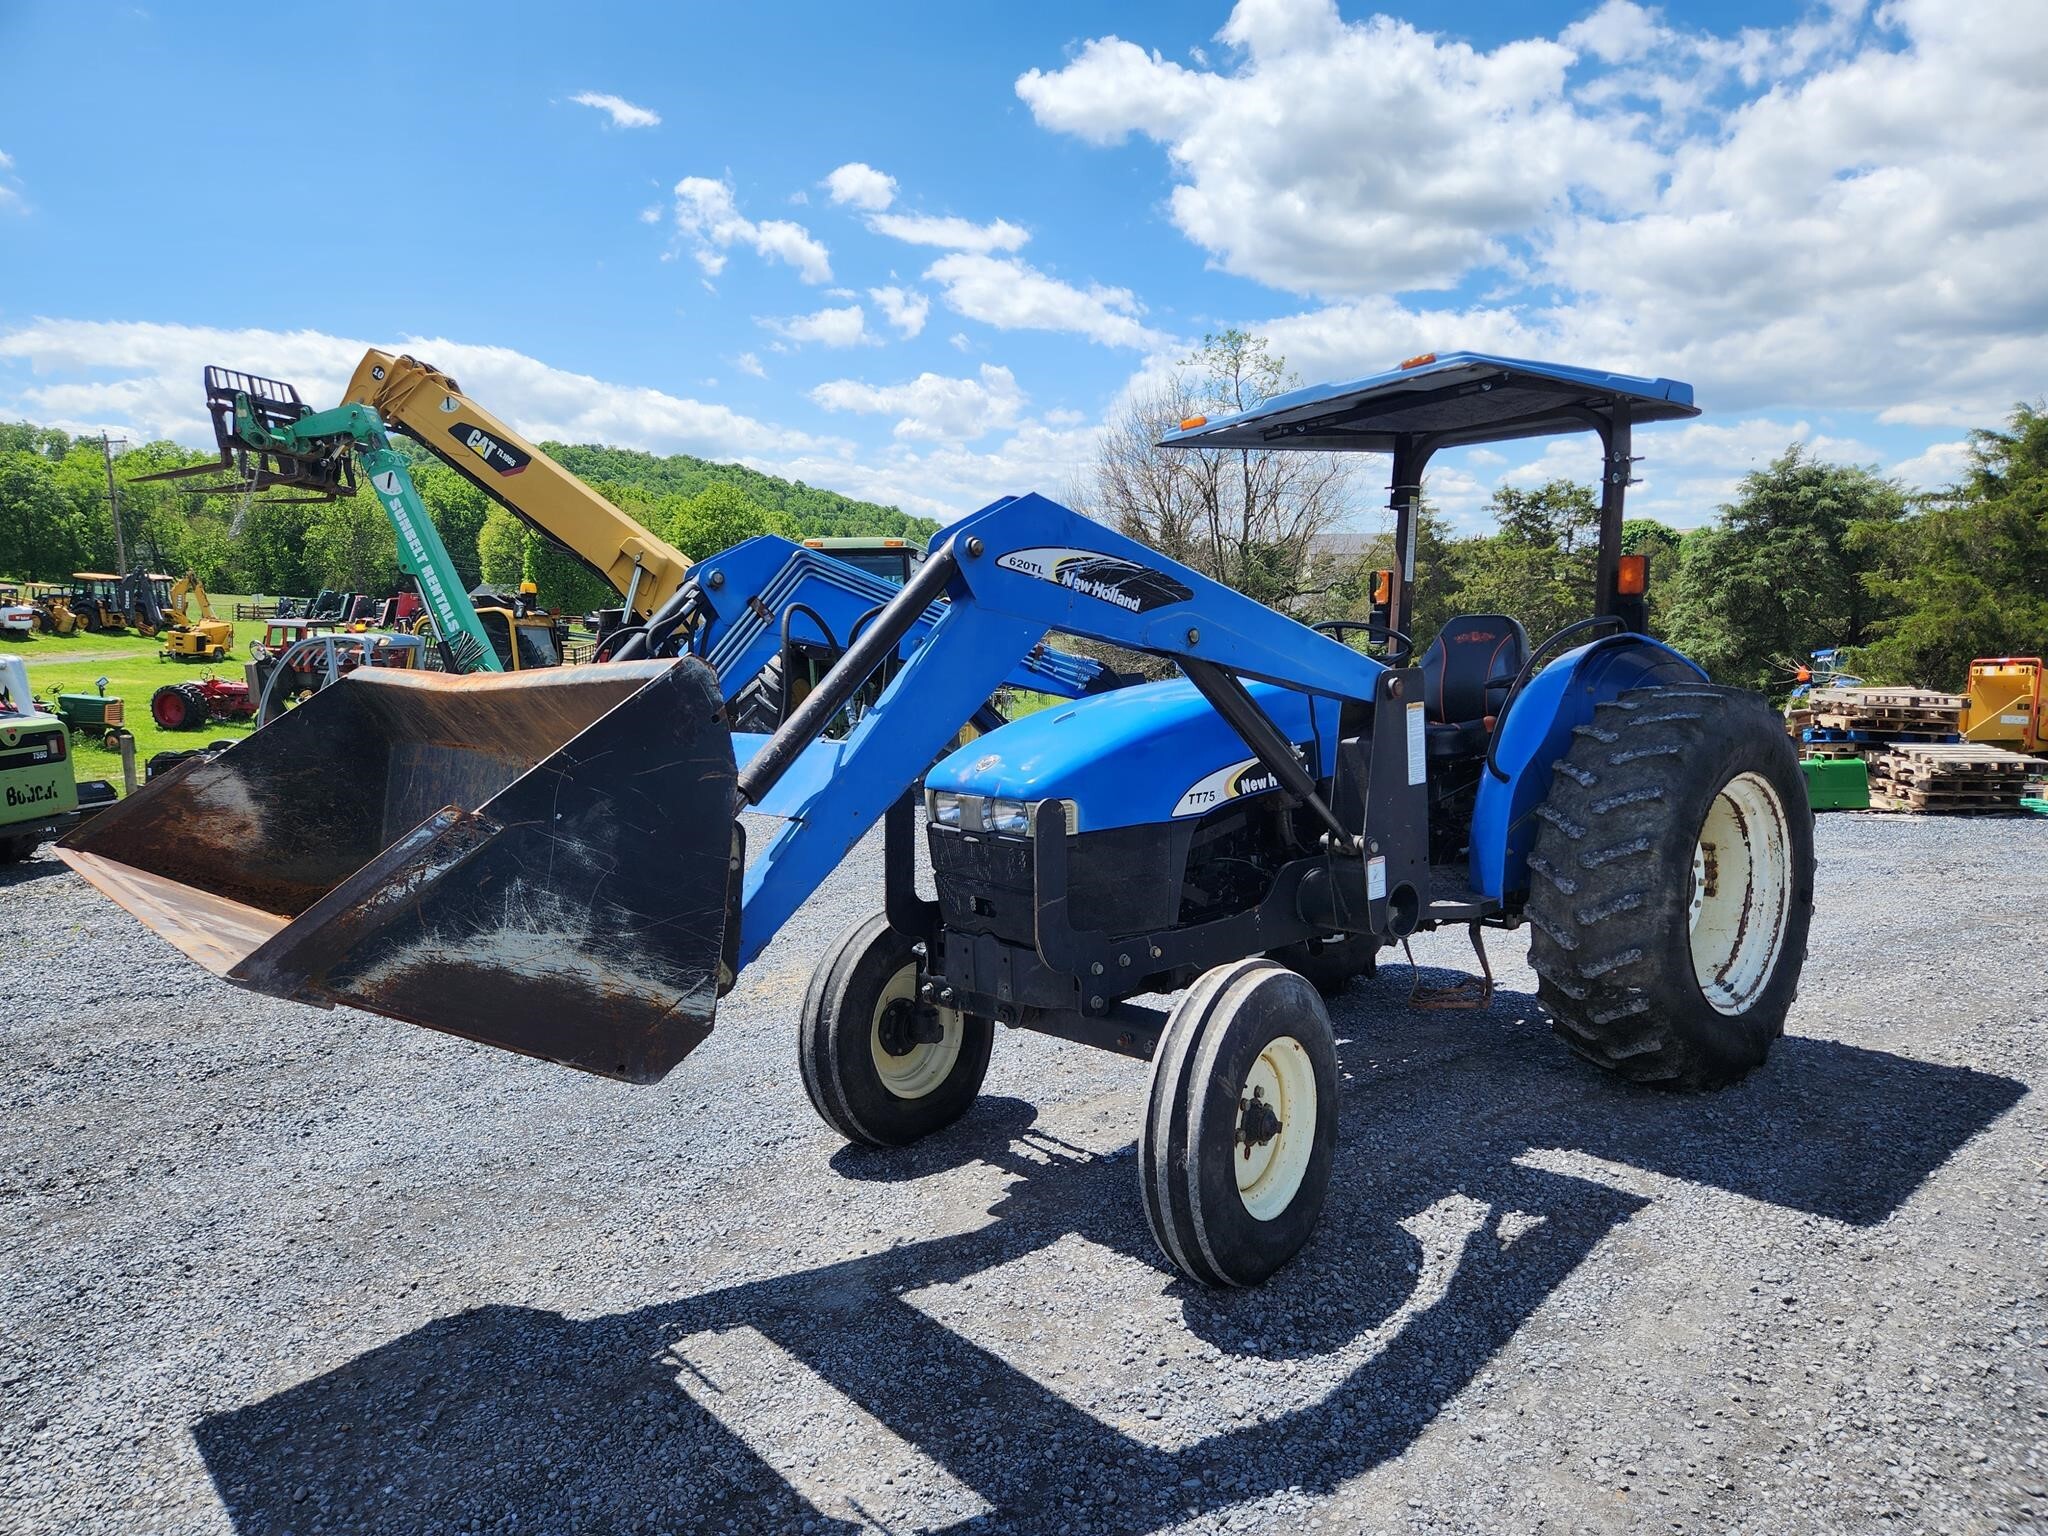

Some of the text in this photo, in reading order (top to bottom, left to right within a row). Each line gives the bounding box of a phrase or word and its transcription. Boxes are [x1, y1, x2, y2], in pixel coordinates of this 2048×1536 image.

[372, 367, 385, 379] 10
[466, 429, 498, 460] CAT
[389, 497, 460, 632] SUNBELT RENTALS
[1009, 556, 1044, 575] 620TL
[1061, 570, 1142, 612] New Holland
[1240, 777, 1267, 795] New
[1188, 790, 1216, 805] TT75
